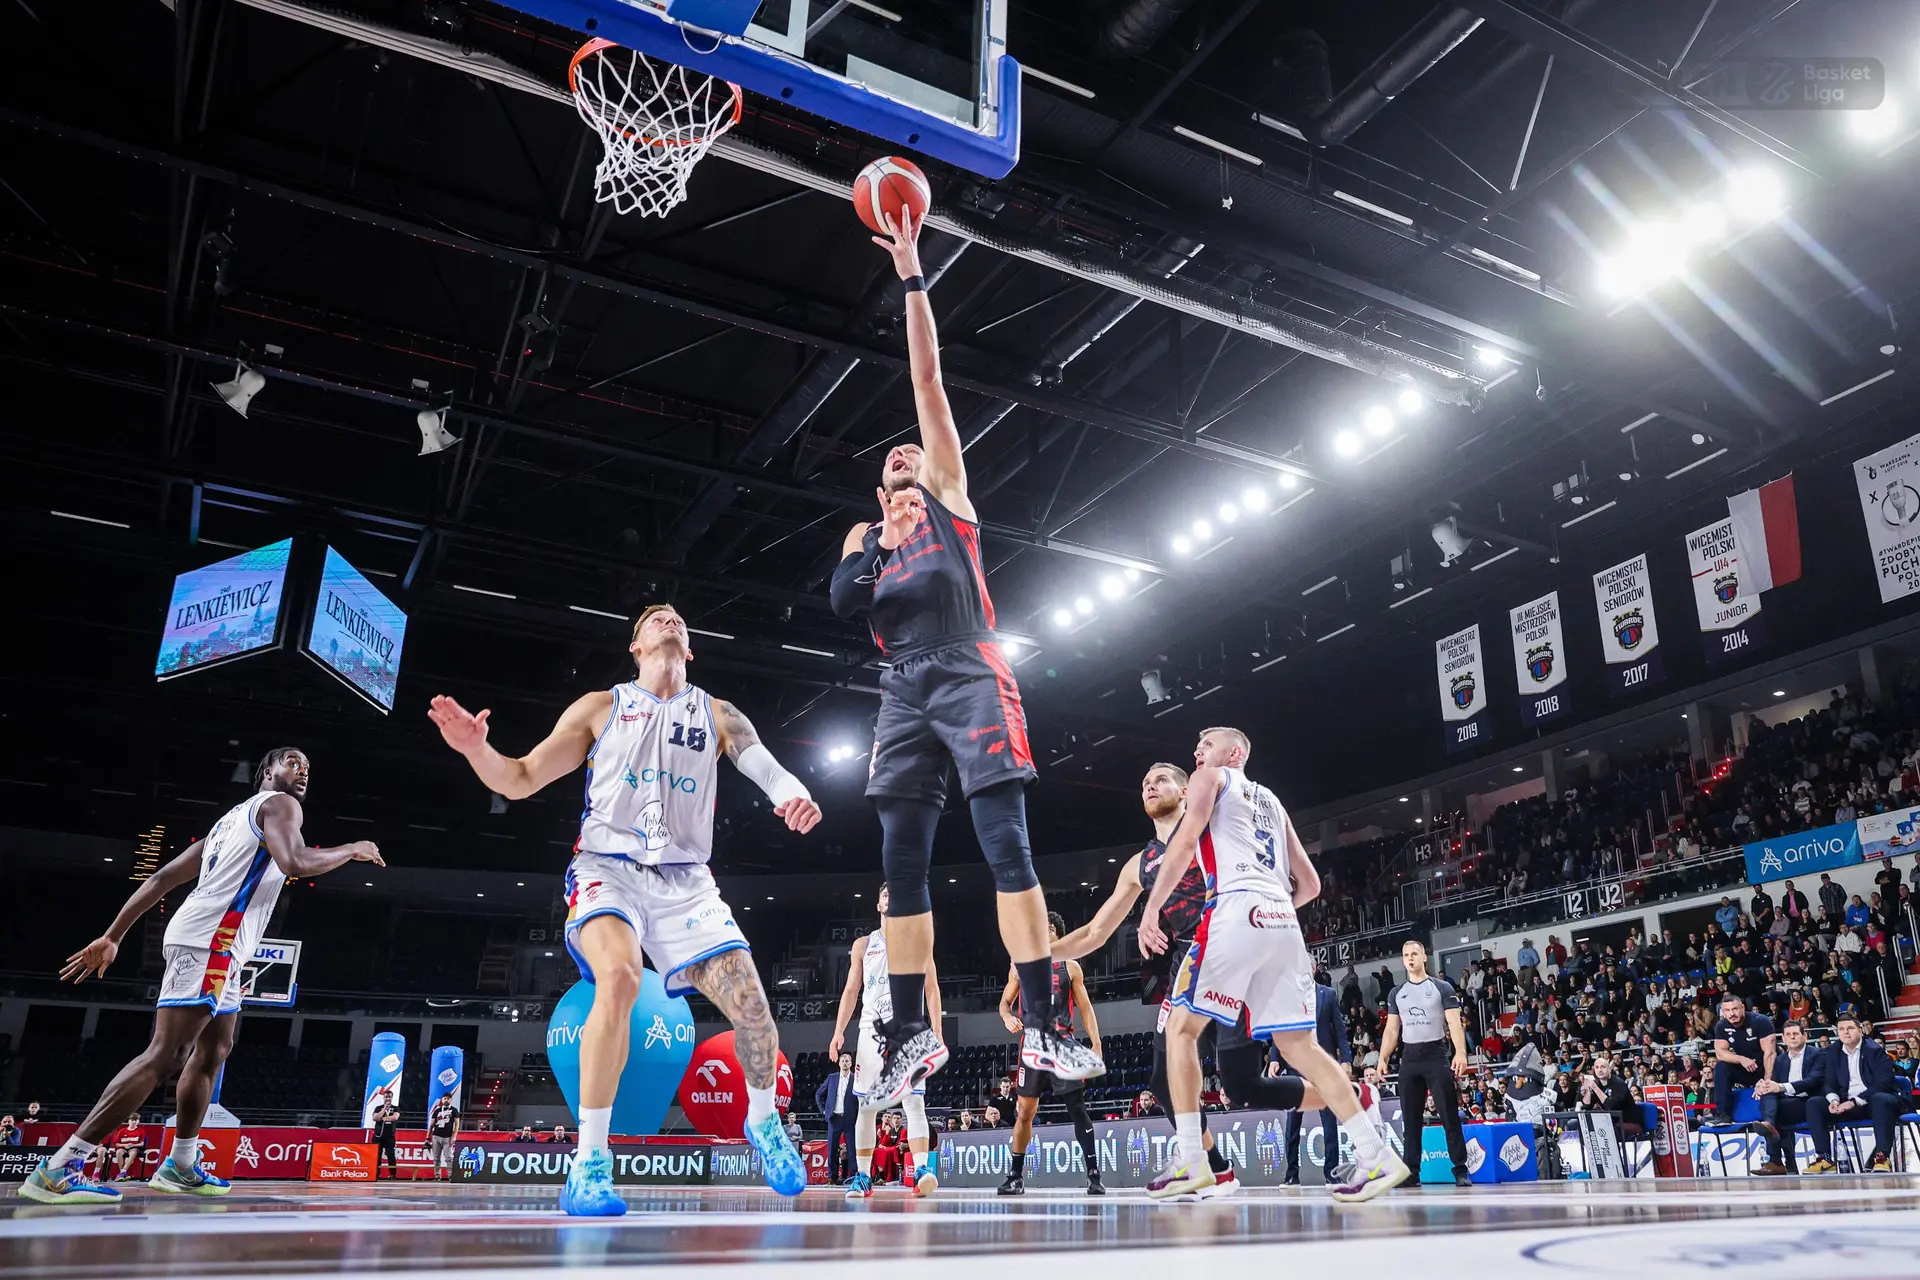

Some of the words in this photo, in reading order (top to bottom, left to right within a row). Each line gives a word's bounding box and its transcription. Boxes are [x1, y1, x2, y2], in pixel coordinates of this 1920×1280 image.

[1689, 523, 1733, 551] WICEMIST
[1702, 537, 1736, 561] POLSKI
[1597, 559, 1644, 588] WICEMISTRZ
[1713, 557, 1729, 572] U14
[1882, 556, 1920, 578] PUCH
[1608, 576, 1637, 596] POLSKI
[174, 580, 273, 630] LENKIEWICZ
[1524, 599, 1551, 620] MIEJSCE
[1603, 585, 1645, 613] SENIORÓW
[1514, 609, 1557, 635] MISTRZOSTW
[1714, 603, 1748, 624] JUNIOR
[325, 590, 395, 664] LENKIEWICZ
[1525, 625, 1549, 643] POLSKI
[1439, 630, 1476, 652] WICEMISTRZ
[1447, 643, 1469, 660] POLSKI
[1722, 629, 1749, 652] 2014
[1444, 652, 1475, 674] SENIORÓW
[1623, 663, 1648, 687] 2017
[1535, 695, 1559, 718] 2018
[668, 721, 707, 753] 18
[1457, 722, 1478, 742] 2019
[1415, 843, 1432, 862] H3
[1784, 837, 1844, 863] arriva
[1600, 884, 1622, 907] J2
[832, 928, 848, 940] F3
[523, 1003, 542, 1016] F2
[778, 1003, 796, 1016] F2
[804, 1003, 822, 1015] G2
[691, 1092, 734, 1104] ORLEN
[265, 1139, 313, 1162] arri
[383, 1148, 435, 1161] RLEN
[320, 1169, 342, 1178] Bank
[343, 1169, 368, 1178] Pekao
[616, 1150, 704, 1176] TORUŃ
[718, 1151, 750, 1176] TORUŃ
